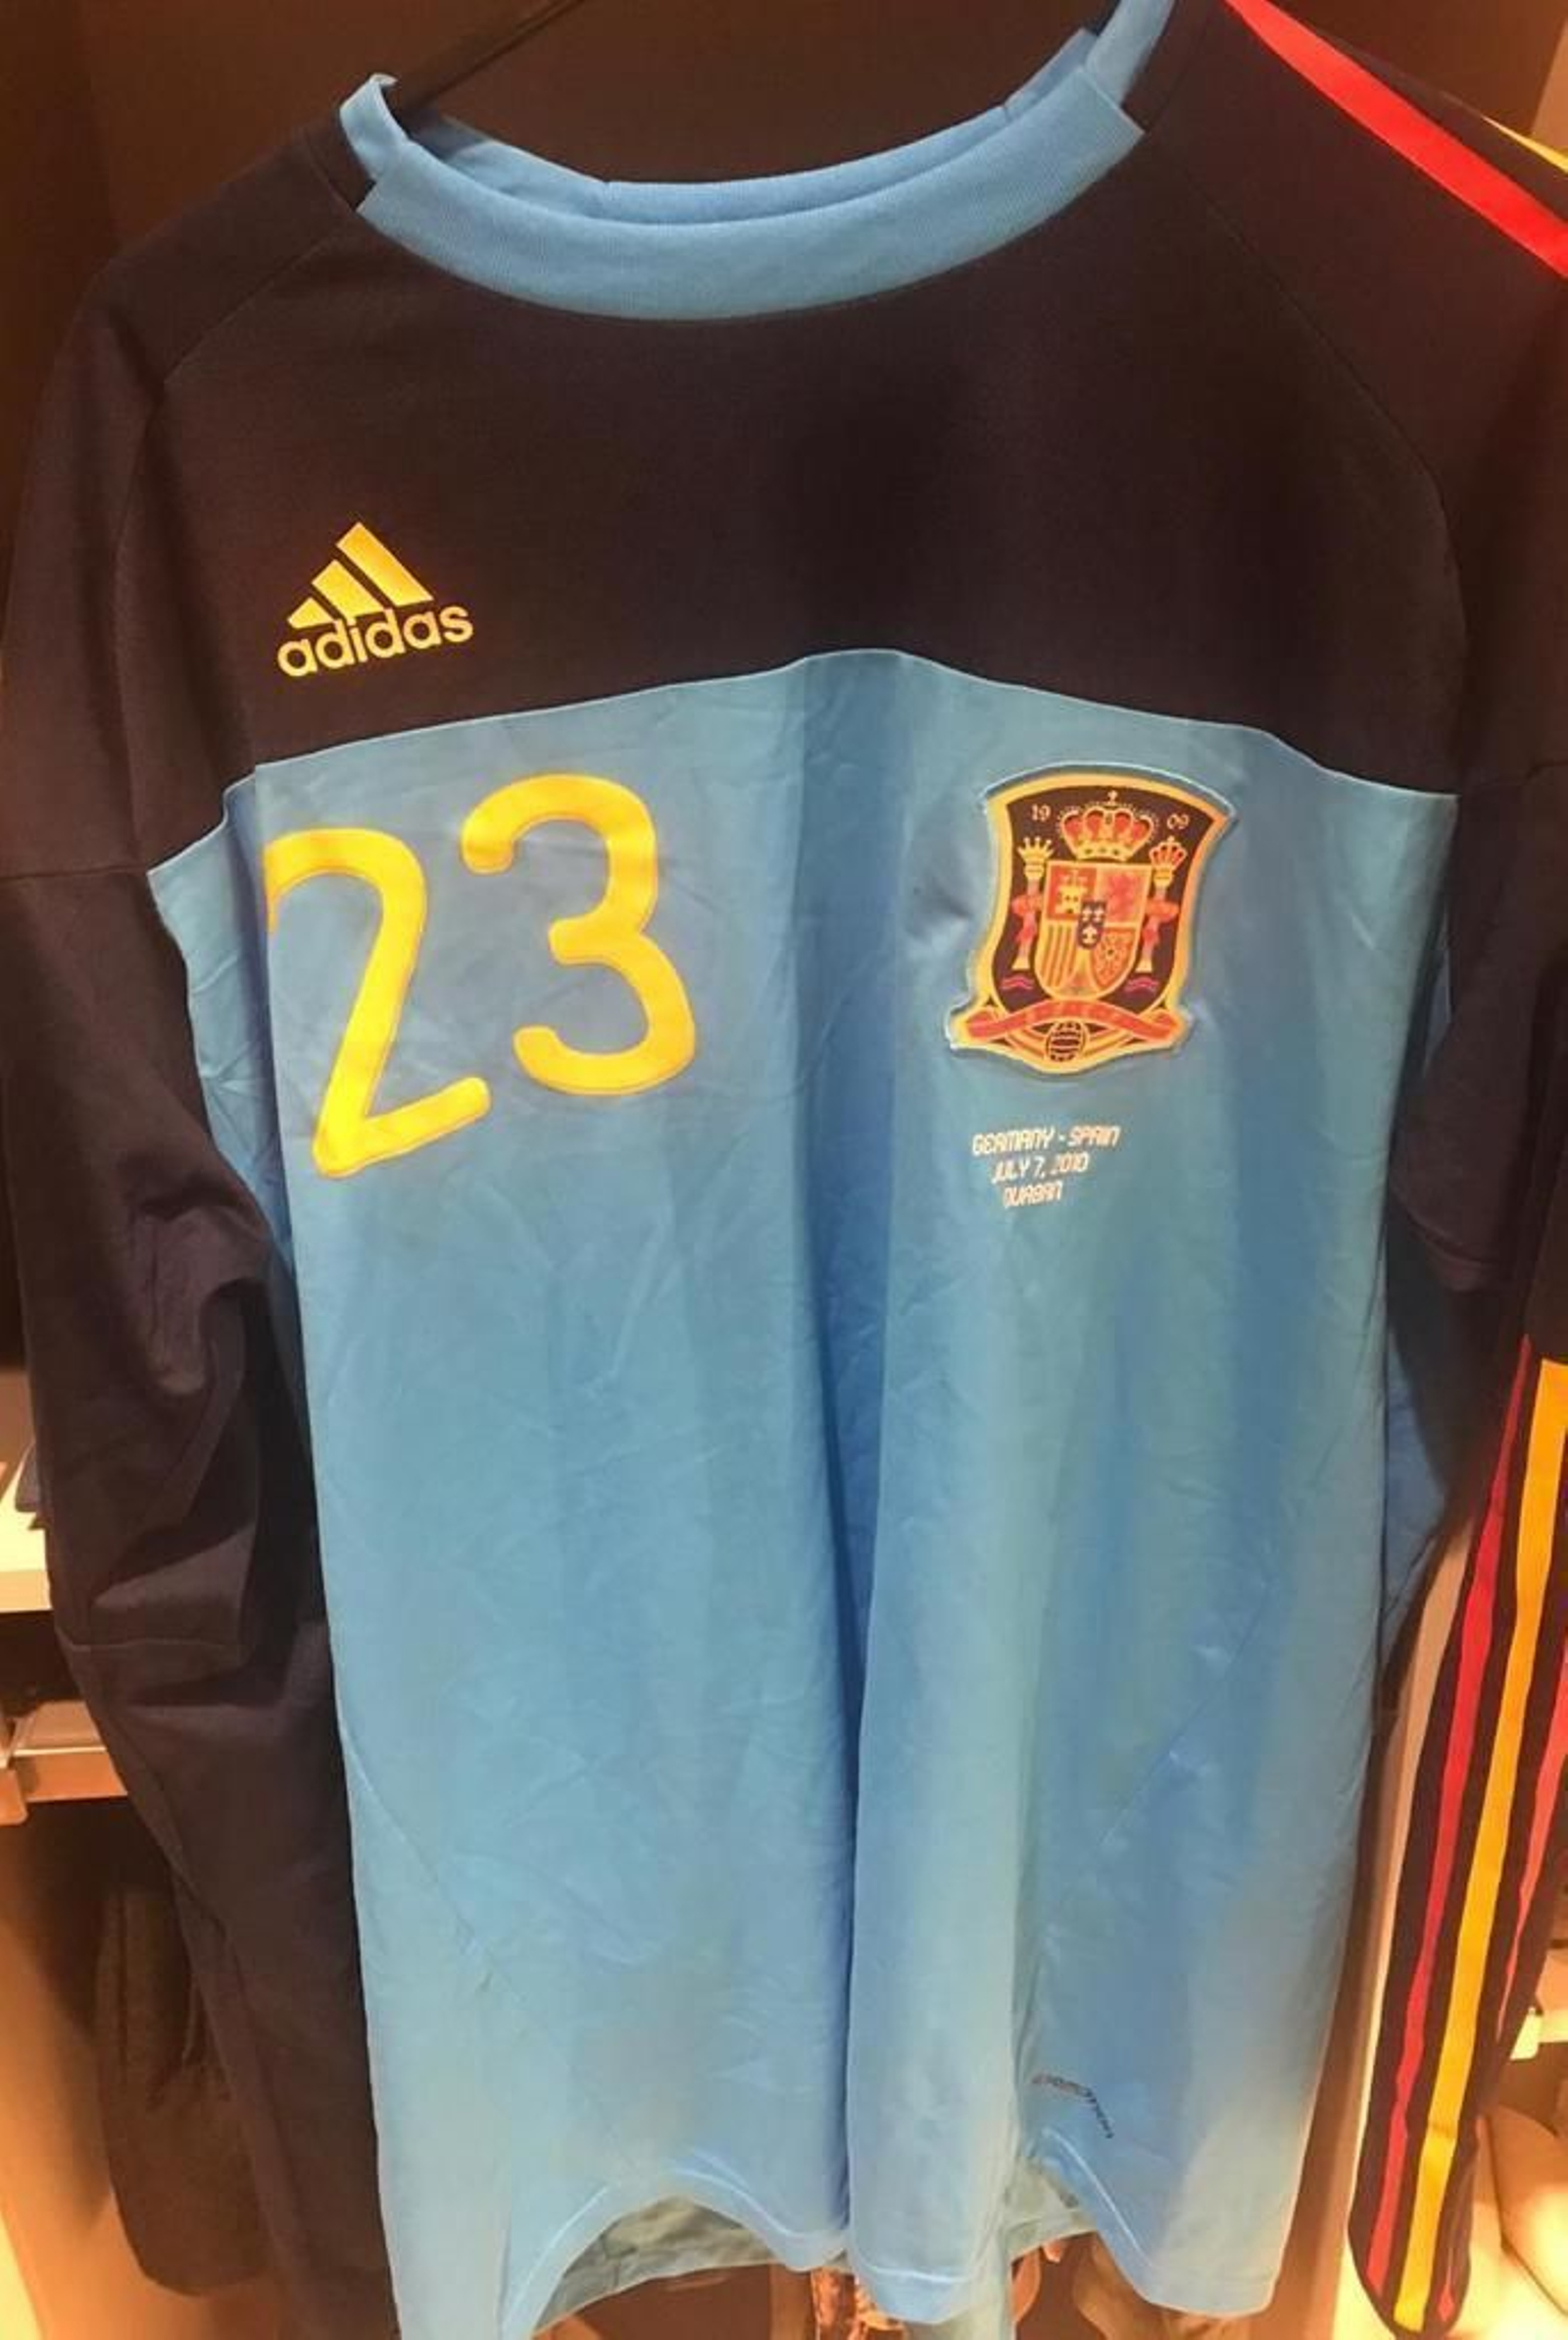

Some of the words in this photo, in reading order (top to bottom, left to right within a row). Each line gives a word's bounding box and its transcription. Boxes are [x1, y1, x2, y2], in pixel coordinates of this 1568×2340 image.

[277, 605, 473, 677] adidas
[1031, 804, 1052, 822] 19
[263, 773, 695, 1178] 23
[972, 1127, 1054, 1156] GERMANY
[1067, 1126, 1120, 1148] SPAIN
[992, 1155, 1030, 1184] JULY
[1004, 1181, 1063, 1208] DURBAN
